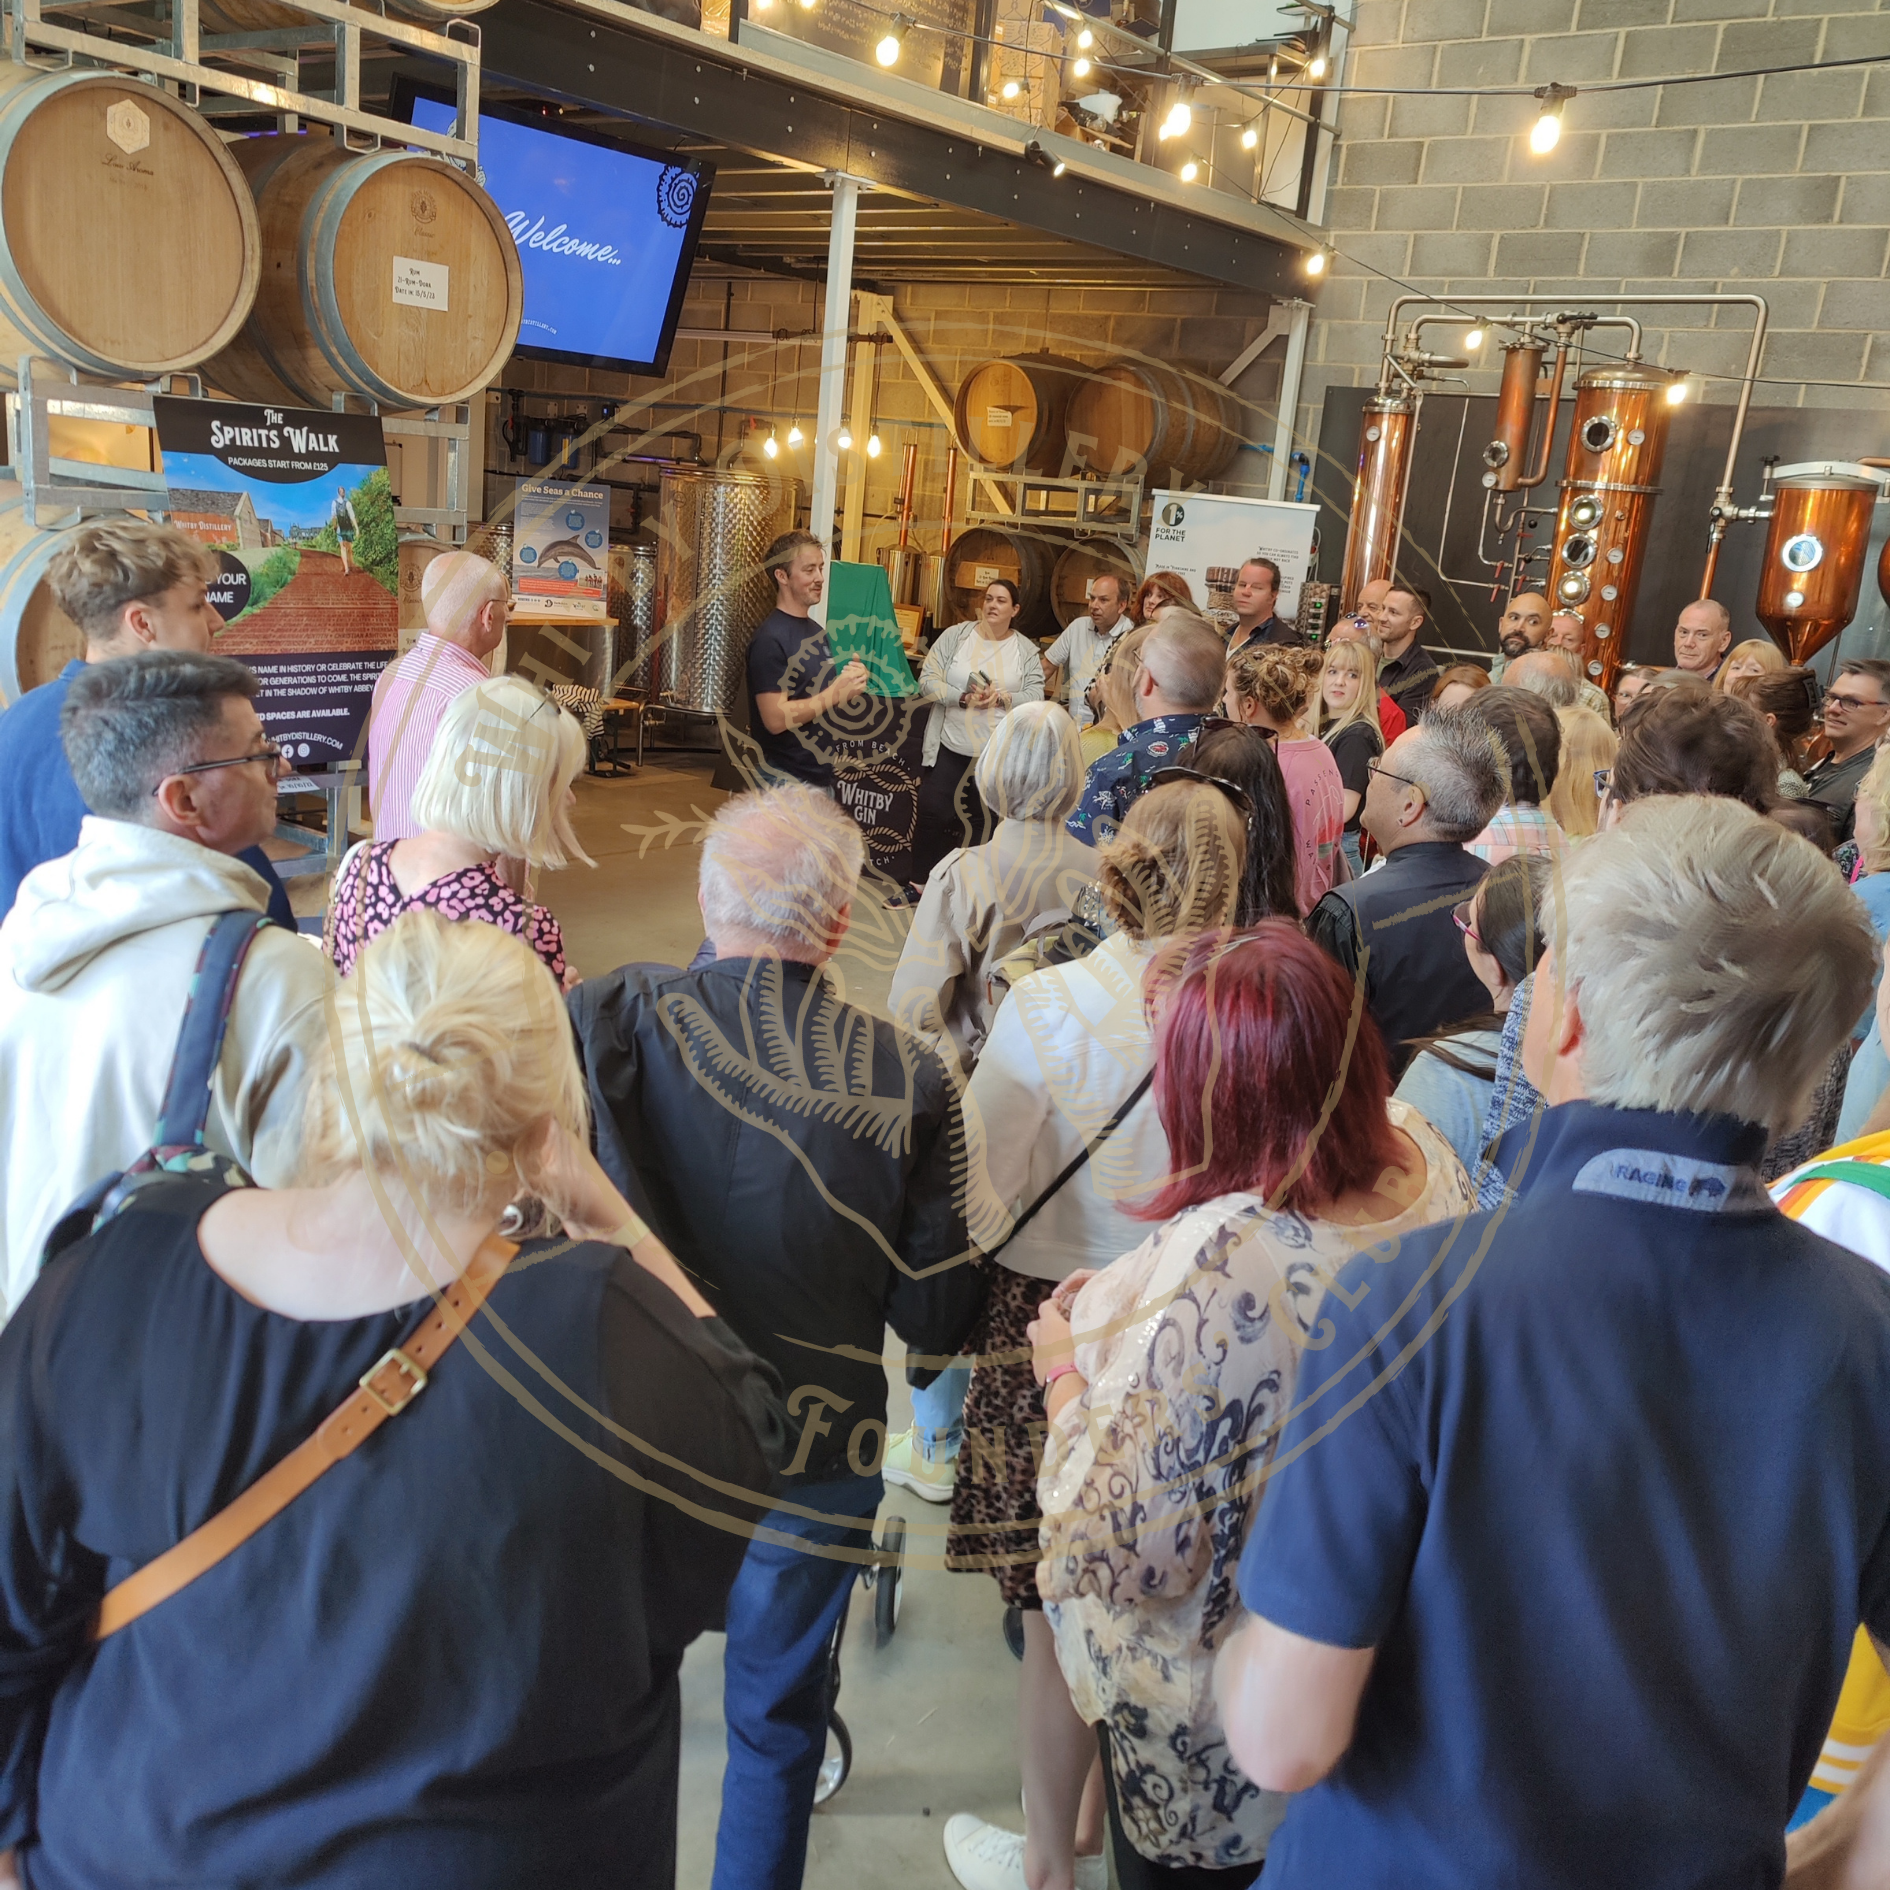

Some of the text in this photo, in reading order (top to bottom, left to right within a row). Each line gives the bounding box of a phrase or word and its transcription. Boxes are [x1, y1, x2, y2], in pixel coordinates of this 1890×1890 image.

[264, 408, 284, 425] THE
[210, 420, 340, 454] SPIRITS WALK
[228, 457, 329, 471] PACKAGES START FROM £125
[521, 484, 542, 494] Give
[543, 486, 563, 496] Seas
[571, 488, 604, 499] Chance
[1155, 533, 1186, 542] PLANET
[1156, 527, 1186, 536] FOR THE
[216, 573, 246, 585] YOUR
[258, 664, 278, 674] NAME
[279, 664, 286, 674] IN
[287, 663, 316, 673] HISTORY
[316, 663, 326, 672] OR
[327, 661, 363, 671] CELEBRATE
[364, 661, 375, 669] THE
[269, 675, 317, 686] GENERATIONS
[317, 675, 327, 683] TO
[350, 673, 362, 681] THE
[265, 689, 273, 697] IN
[273, 688, 287, 697] THE
[287, 686, 318, 697] SHADOW
[318, 686, 328, 695] OF
[328, 685, 353, 695] WHITBY
[353, 684, 374, 693] ABBEY
[266, 711, 296, 721] SPACES
[296, 710, 311, 719] ARE
[311, 707, 350, 718] AVAILABLE.
[836, 739, 906, 767] FROM BEACH
[836, 780, 893, 812] WHITBY
[854, 805, 877, 825] GIN
